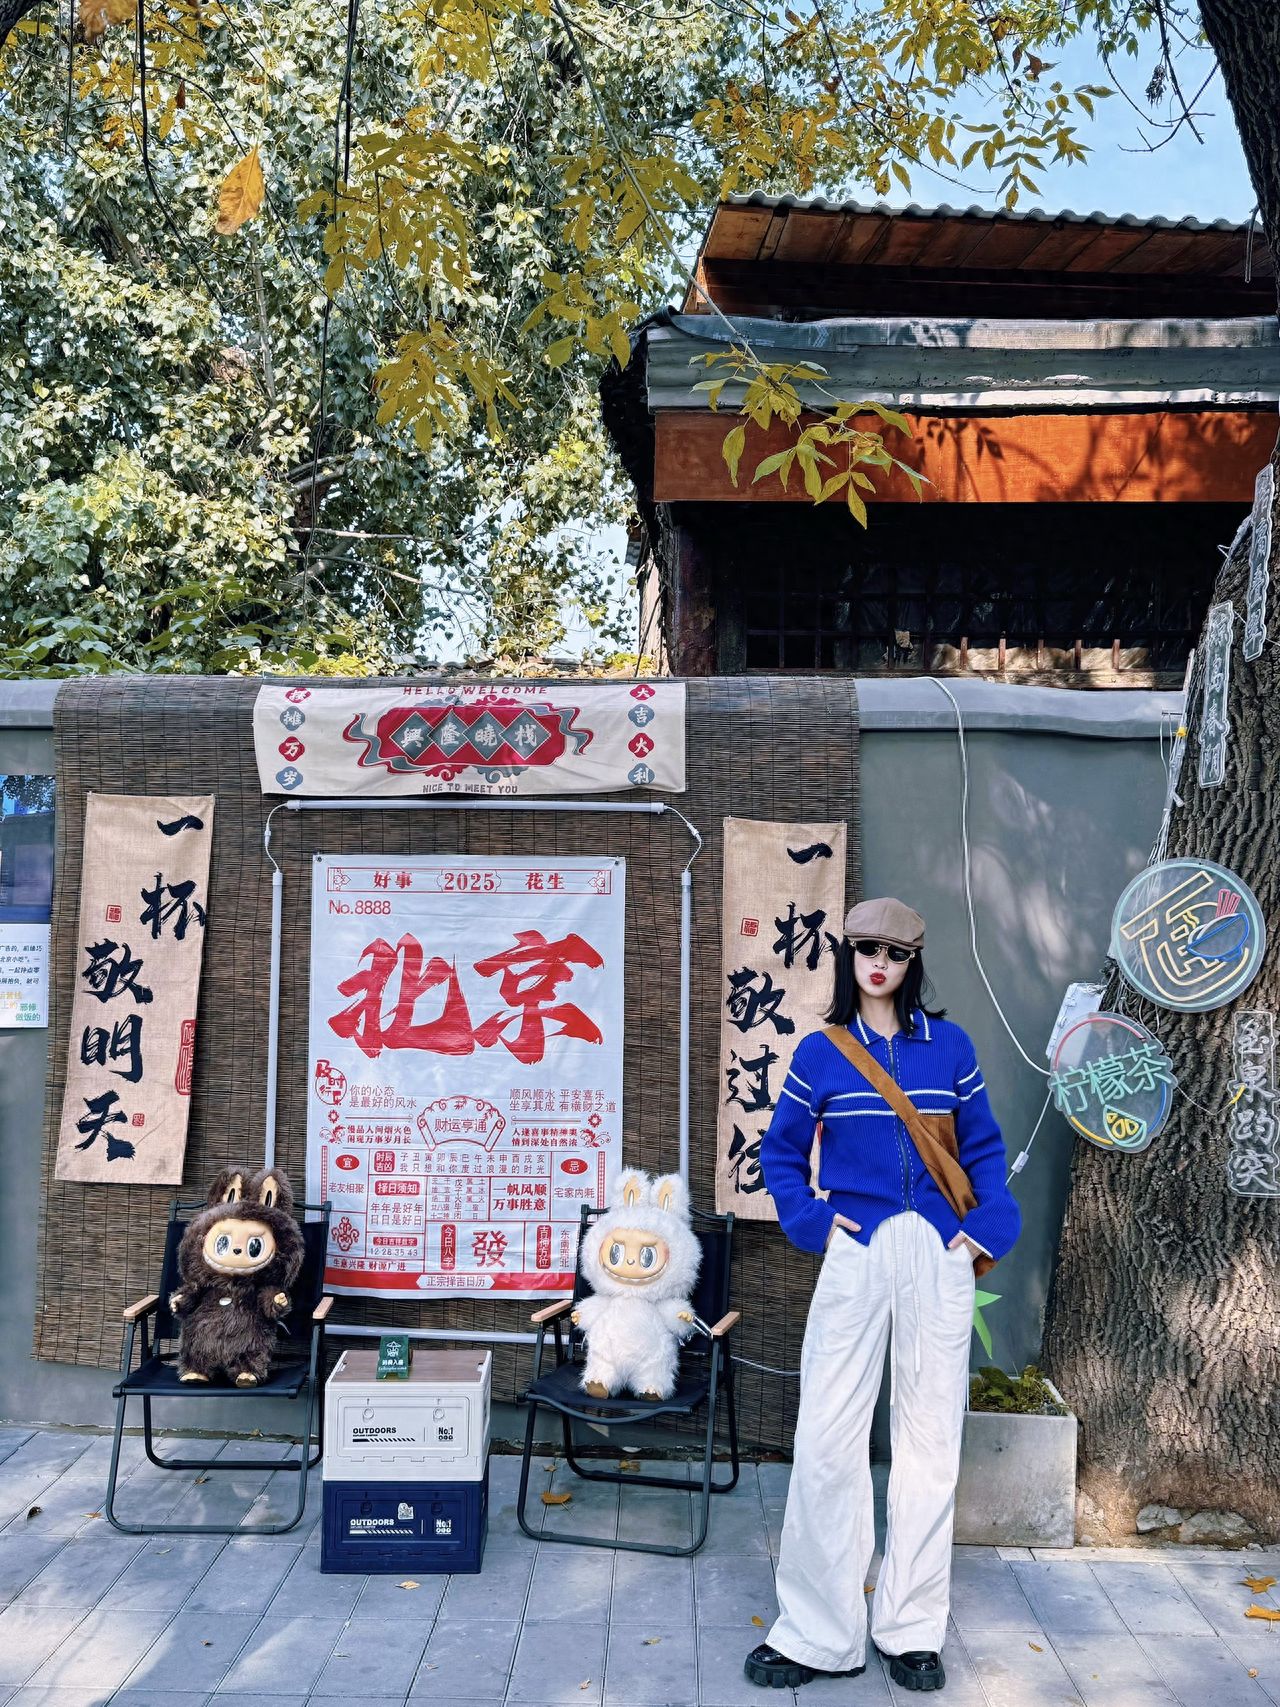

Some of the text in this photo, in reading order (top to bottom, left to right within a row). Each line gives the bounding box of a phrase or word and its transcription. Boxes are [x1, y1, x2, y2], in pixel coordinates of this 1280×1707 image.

[403, 686, 548, 695] HELLO WELCOME
[633, 688, 651, 784] 大吉大利
[422, 783, 518, 794] NICE TO MEET YOU
[373, 871, 565, 891] 好事 2025 花生
[328, 900, 391, 915] No.8888
[328, 930, 604, 1065] 北京
[74, 938, 154, 1162] 敬明天
[1051, 1041, 1173, 1117] 柠檬茶
[349, 1085, 395, 1096] 你的心态
[510, 1089, 605, 1101] 顺风顺水 平安喜乐
[349, 1098, 417, 1109] 是最好的风水
[510, 1101, 617, 1113] 坐享其成 有横财之道
[434, 1118, 488, 1133] 财运亨通
[512, 1128, 577, 1137] 人逢喜事精神爽
[512, 1138, 578, 1147] 情到深处自然浓
[343, 1157, 353, 1168] 宜
[569, 1160, 579, 1171] 忌
[329, 1182, 365, 1194] 老友相聚
[377, 1182, 417, 1194] 择日须知
[493, 1183, 547, 1196] 一帆风顺
[554, 1187, 595, 1198] 宅家内耗
[370, 1202, 424, 1213] 年年是好年
[493, 1198, 546, 1210] 万事胜意
[370, 1214, 422, 1226] 日日是好日
[382, 1248, 392, 1256] 28
[407, 1249, 418, 1257] 43
[442, 1227, 454, 1266] 今日八字
[471, 1230, 509, 1268] 發
[333, 1259, 407, 1272] 生意兴隆 财源广进
[427, 1275, 486, 1287] 正宗择吉日历
[438, 1427, 454, 1435] No.1
[436, 1519, 452, 1527] No.1
